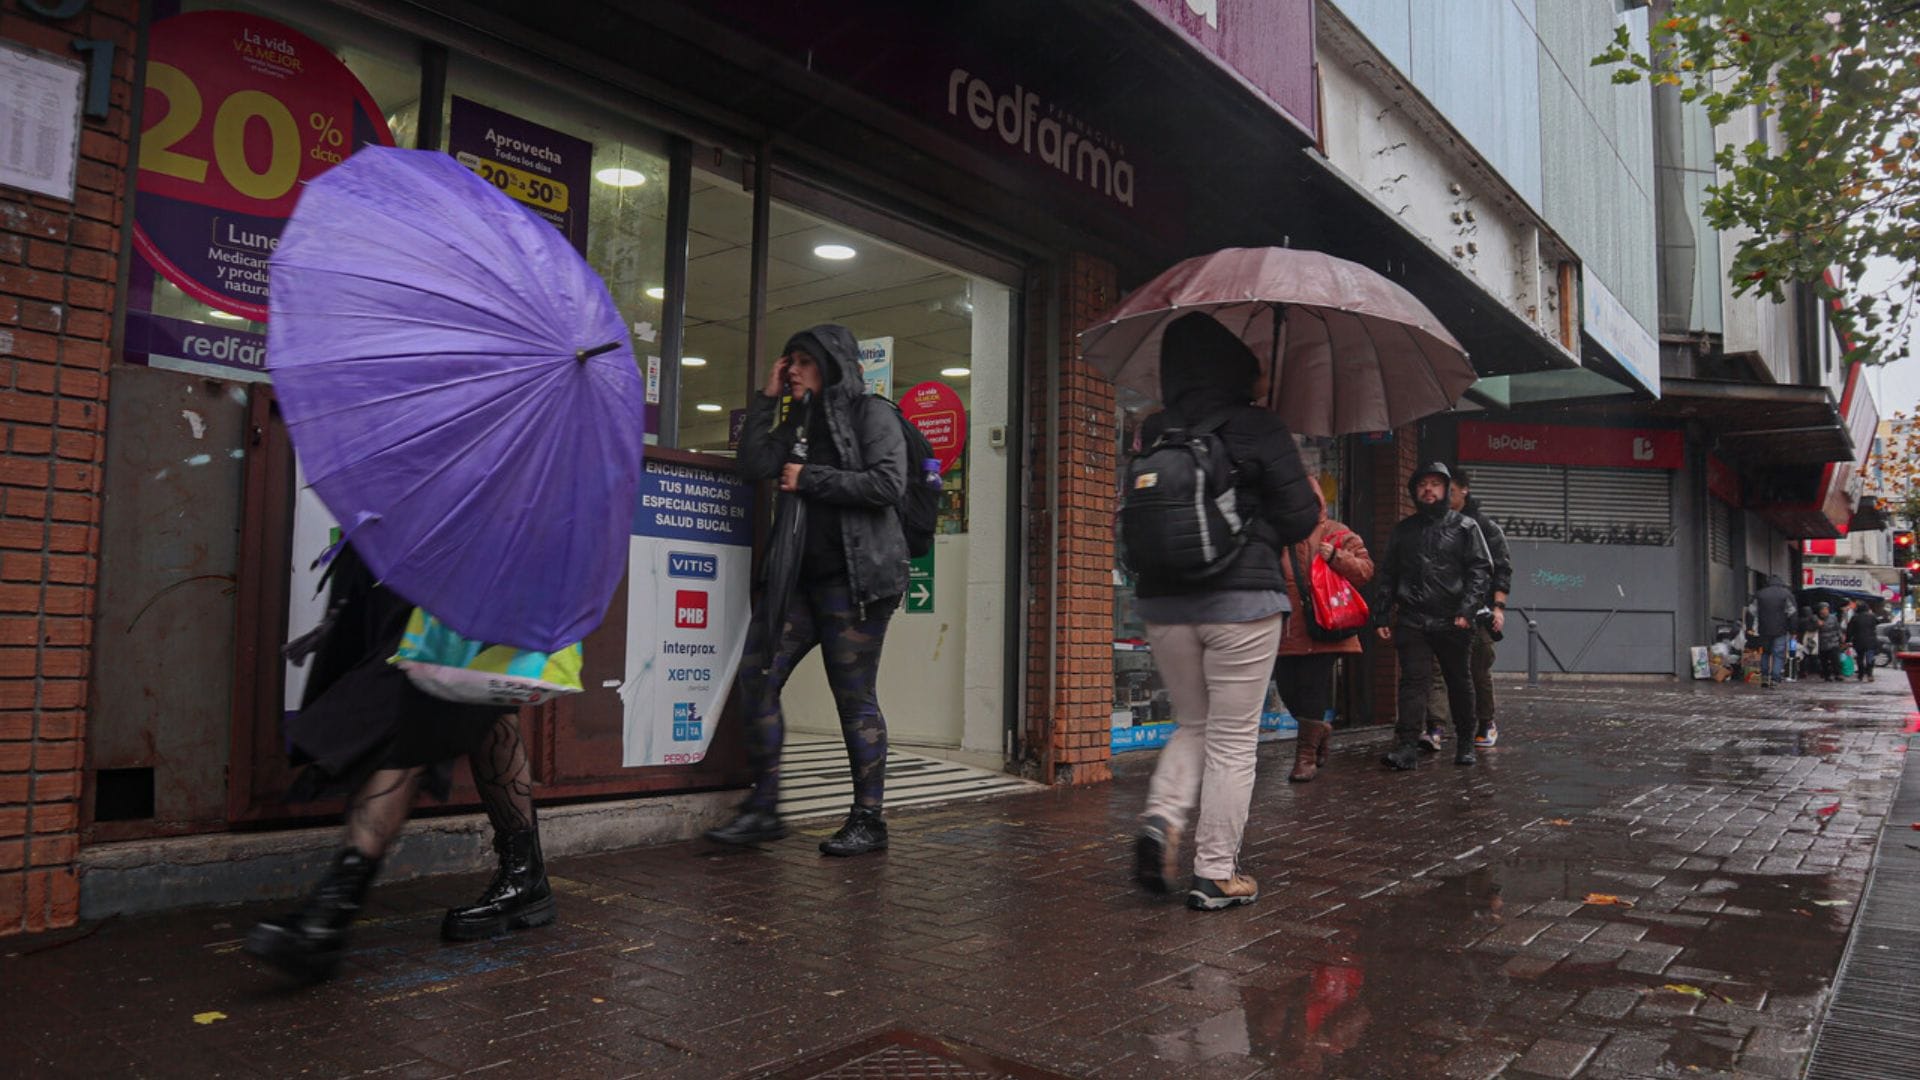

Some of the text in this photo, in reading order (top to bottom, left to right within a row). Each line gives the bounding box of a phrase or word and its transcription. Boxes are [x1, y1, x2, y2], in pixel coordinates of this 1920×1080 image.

[243, 28, 296, 56] La vida
[233, 40, 254, 56] VA
[256, 49, 303, 70] MEJOR
[72, 40, 114, 117] 1
[484, 128, 562, 165] Aprovecha
[948, 68, 1134, 207] redfarma
[310, 145, 342, 164] dcto
[495, 147, 520, 163] Todos
[521, 157, 534, 168] los
[519, 180, 526, 190] a
[216, 265, 226, 278] y
[918, 417, 952, 427] Mejoramos
[1488, 434, 1538, 450] laPolar
[646, 461, 715, 482] ENCUENTRA
[659, 480, 731, 500] TUS MARCAS
[642, 495, 745, 518] ESPECIALISTAS EN
[656, 513, 733, 532] SALUD BUCAL
[672, 558, 713, 573] VITIS
[678, 607, 705, 624] PHB
[667, 668, 711, 681] xeros
